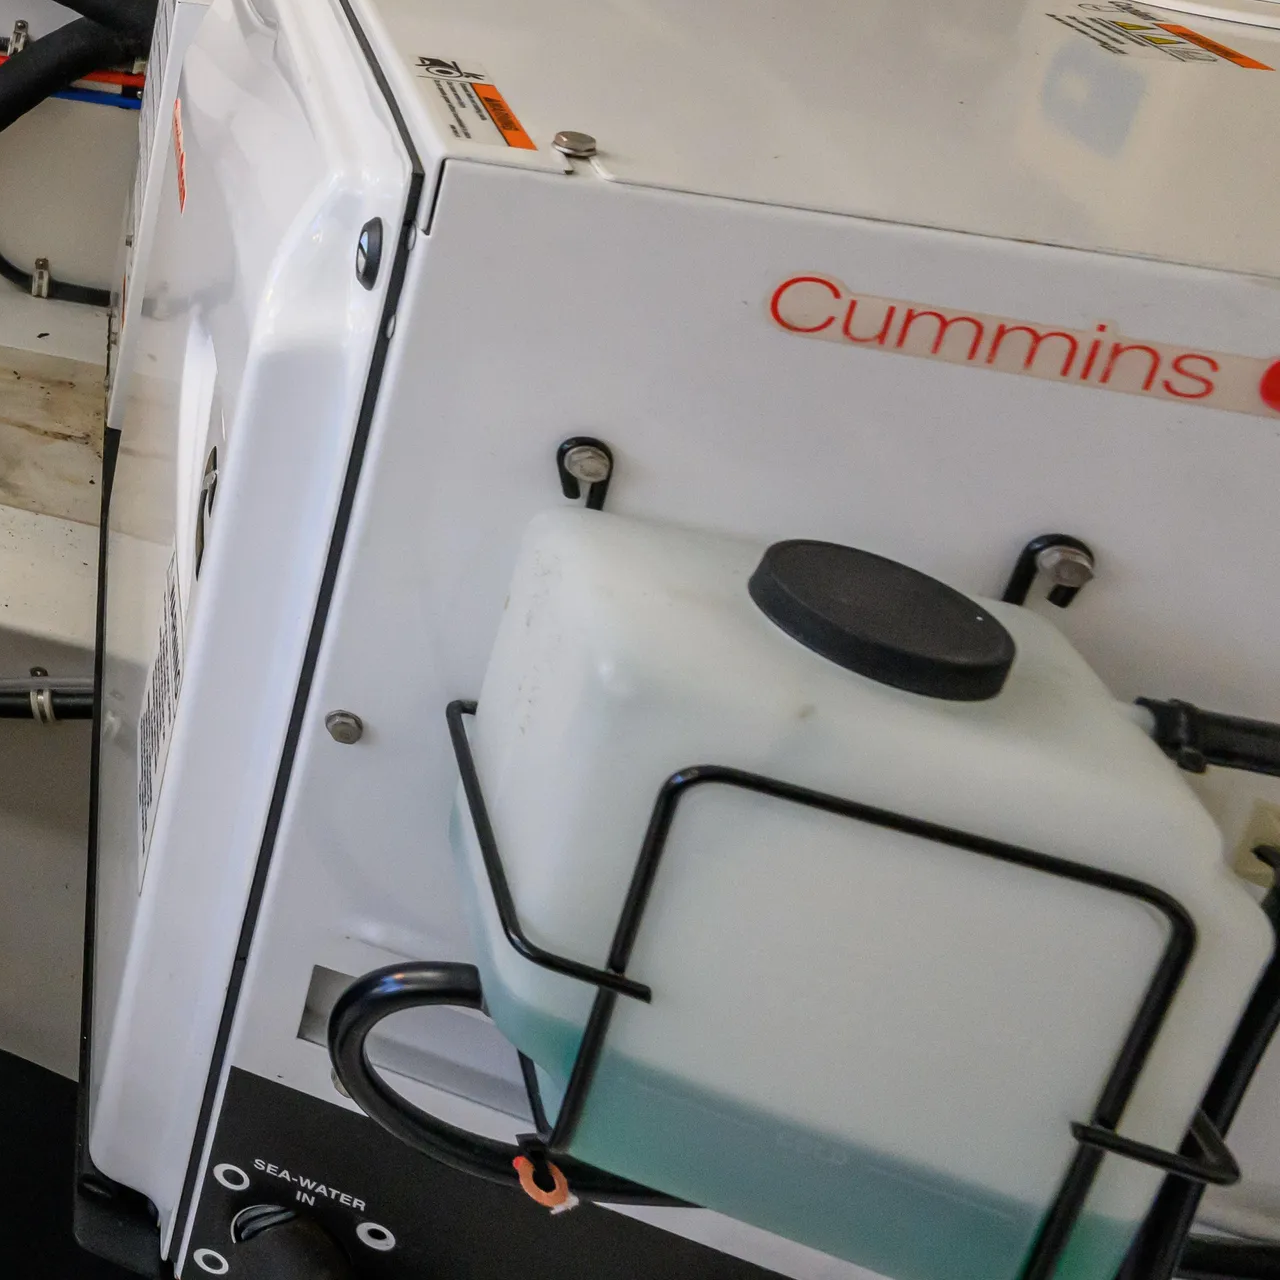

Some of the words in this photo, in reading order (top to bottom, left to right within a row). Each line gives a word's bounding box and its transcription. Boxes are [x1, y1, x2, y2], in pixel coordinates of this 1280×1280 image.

[770, 276, 1219, 399] Cummins
[253, 1158, 366, 1212] SEA-WATER
[296, 1190, 316, 1207] IN
